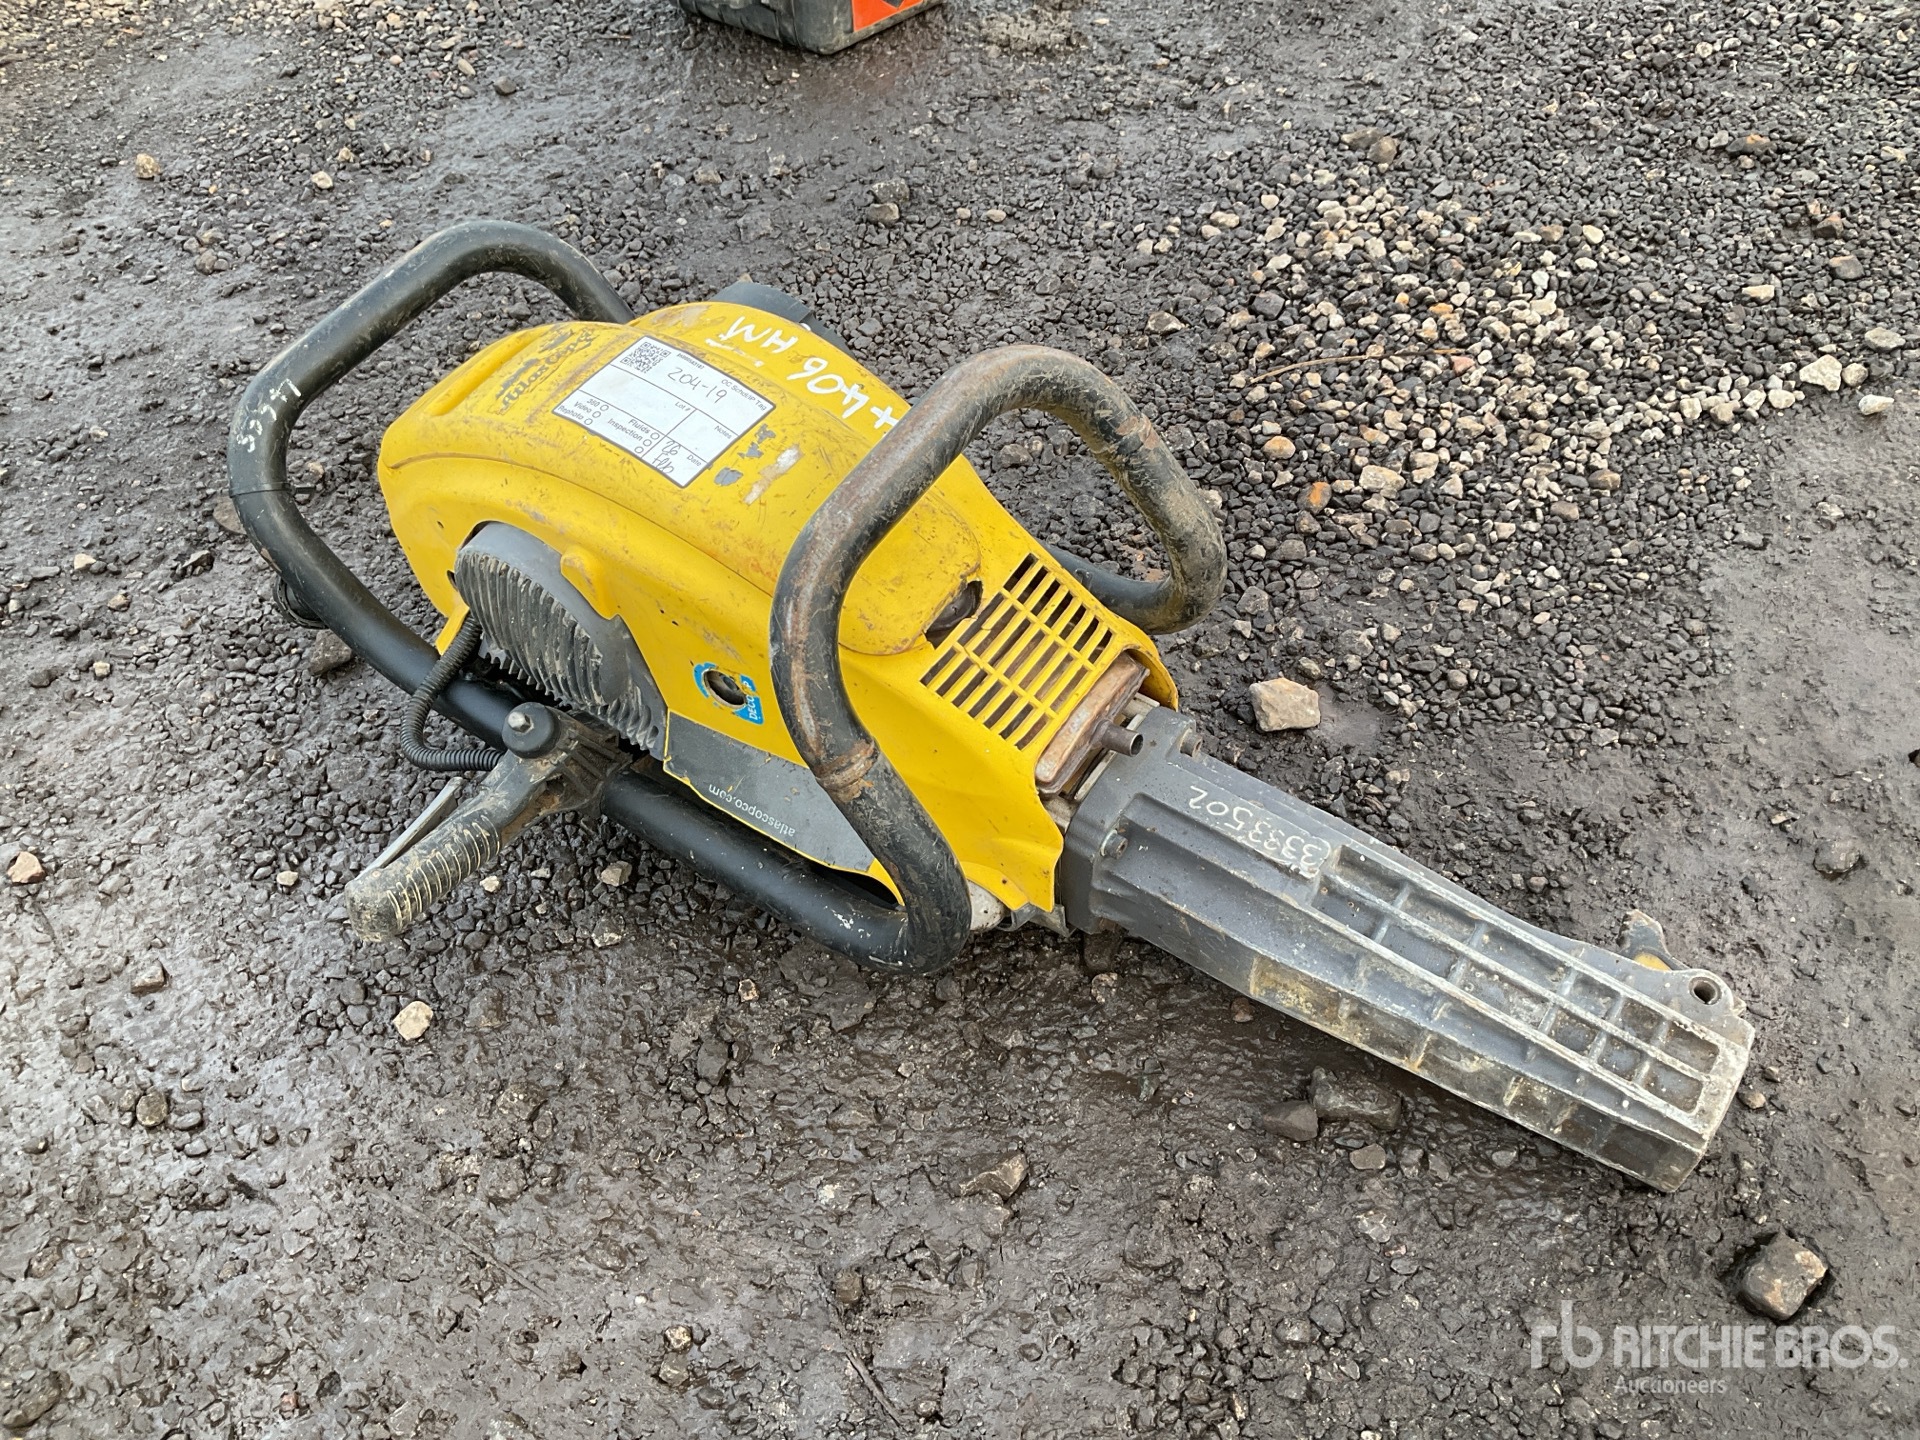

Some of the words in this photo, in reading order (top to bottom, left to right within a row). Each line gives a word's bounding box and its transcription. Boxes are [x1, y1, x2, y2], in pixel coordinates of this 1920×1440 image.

[667, 366, 728, 404] 204-19
[557, 405, 585, 421] Rephoto
[573, 401, 593, 414] Video
[607, 417, 643, 442] Inspection
[628, 418, 652, 434] Fluids
[713, 424, 732, 440] Notes
[686, 453, 702, 467] Date
[708, 783, 796, 837] atlascopco.com
